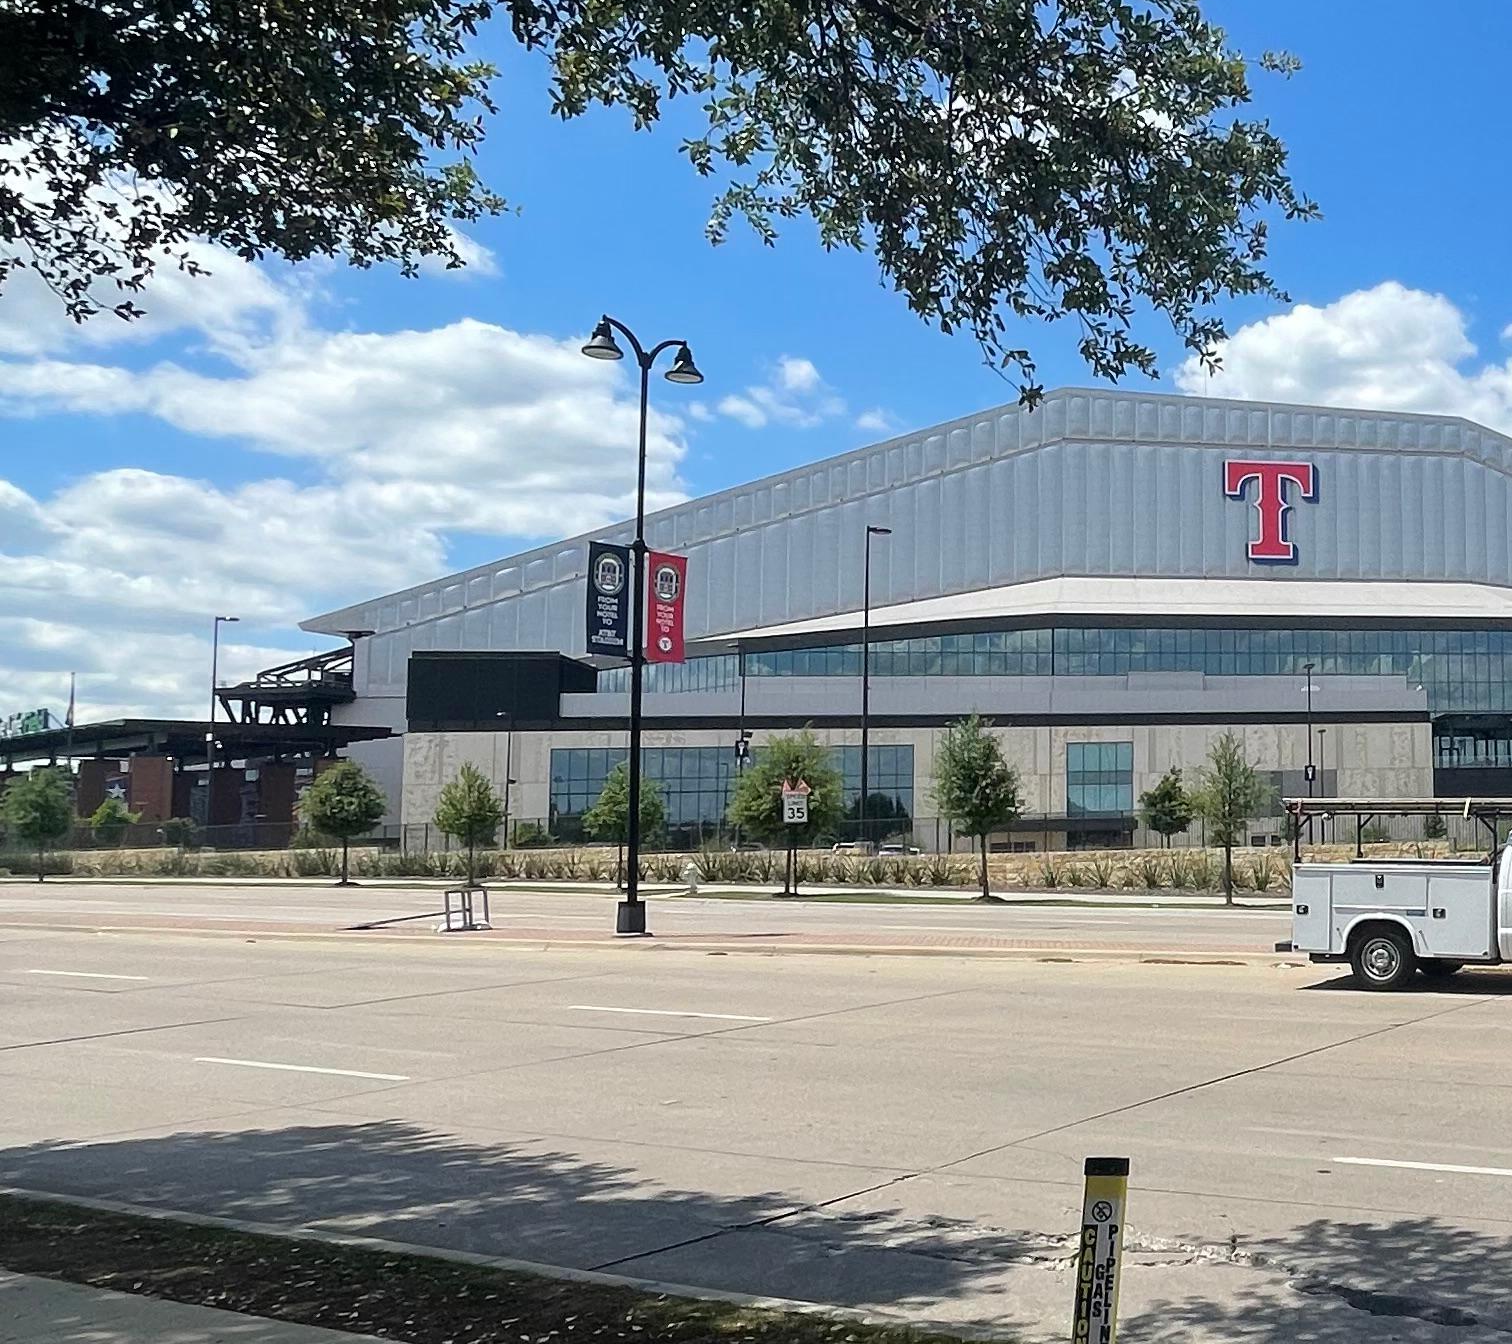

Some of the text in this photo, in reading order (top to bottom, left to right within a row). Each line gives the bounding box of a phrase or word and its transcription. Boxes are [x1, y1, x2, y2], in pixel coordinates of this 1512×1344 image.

[1223, 459, 1315, 560] T
[602, 618, 613, 626] TO
[787, 807, 805, 820] 35
[1092, 1263, 1106, 1319] GAS
